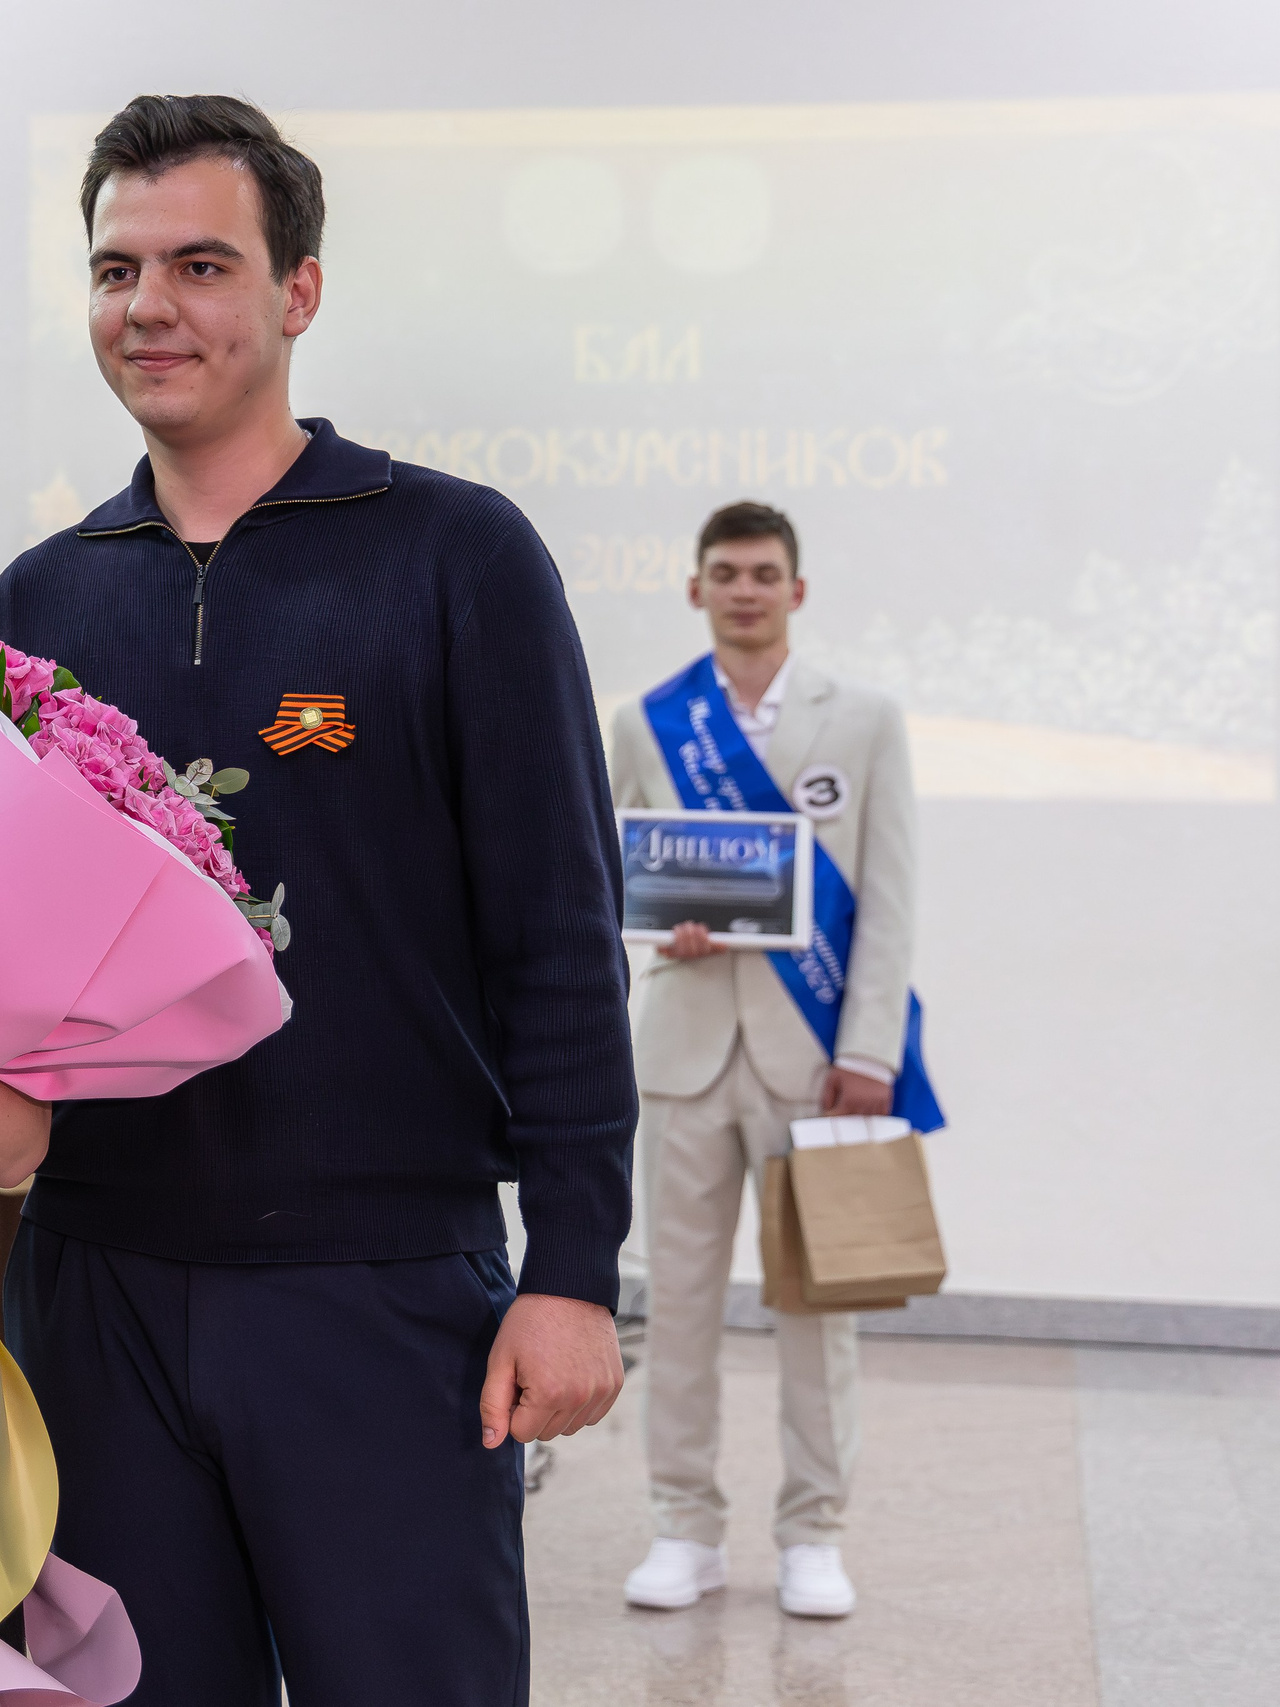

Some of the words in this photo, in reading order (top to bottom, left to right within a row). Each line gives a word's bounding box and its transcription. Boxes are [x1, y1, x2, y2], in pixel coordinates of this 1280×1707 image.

[573, 324, 703, 384] БАЛ
[340, 426, 951, 491] РВОКУРСНИКОВ
[803, 774, 840, 808] 3
